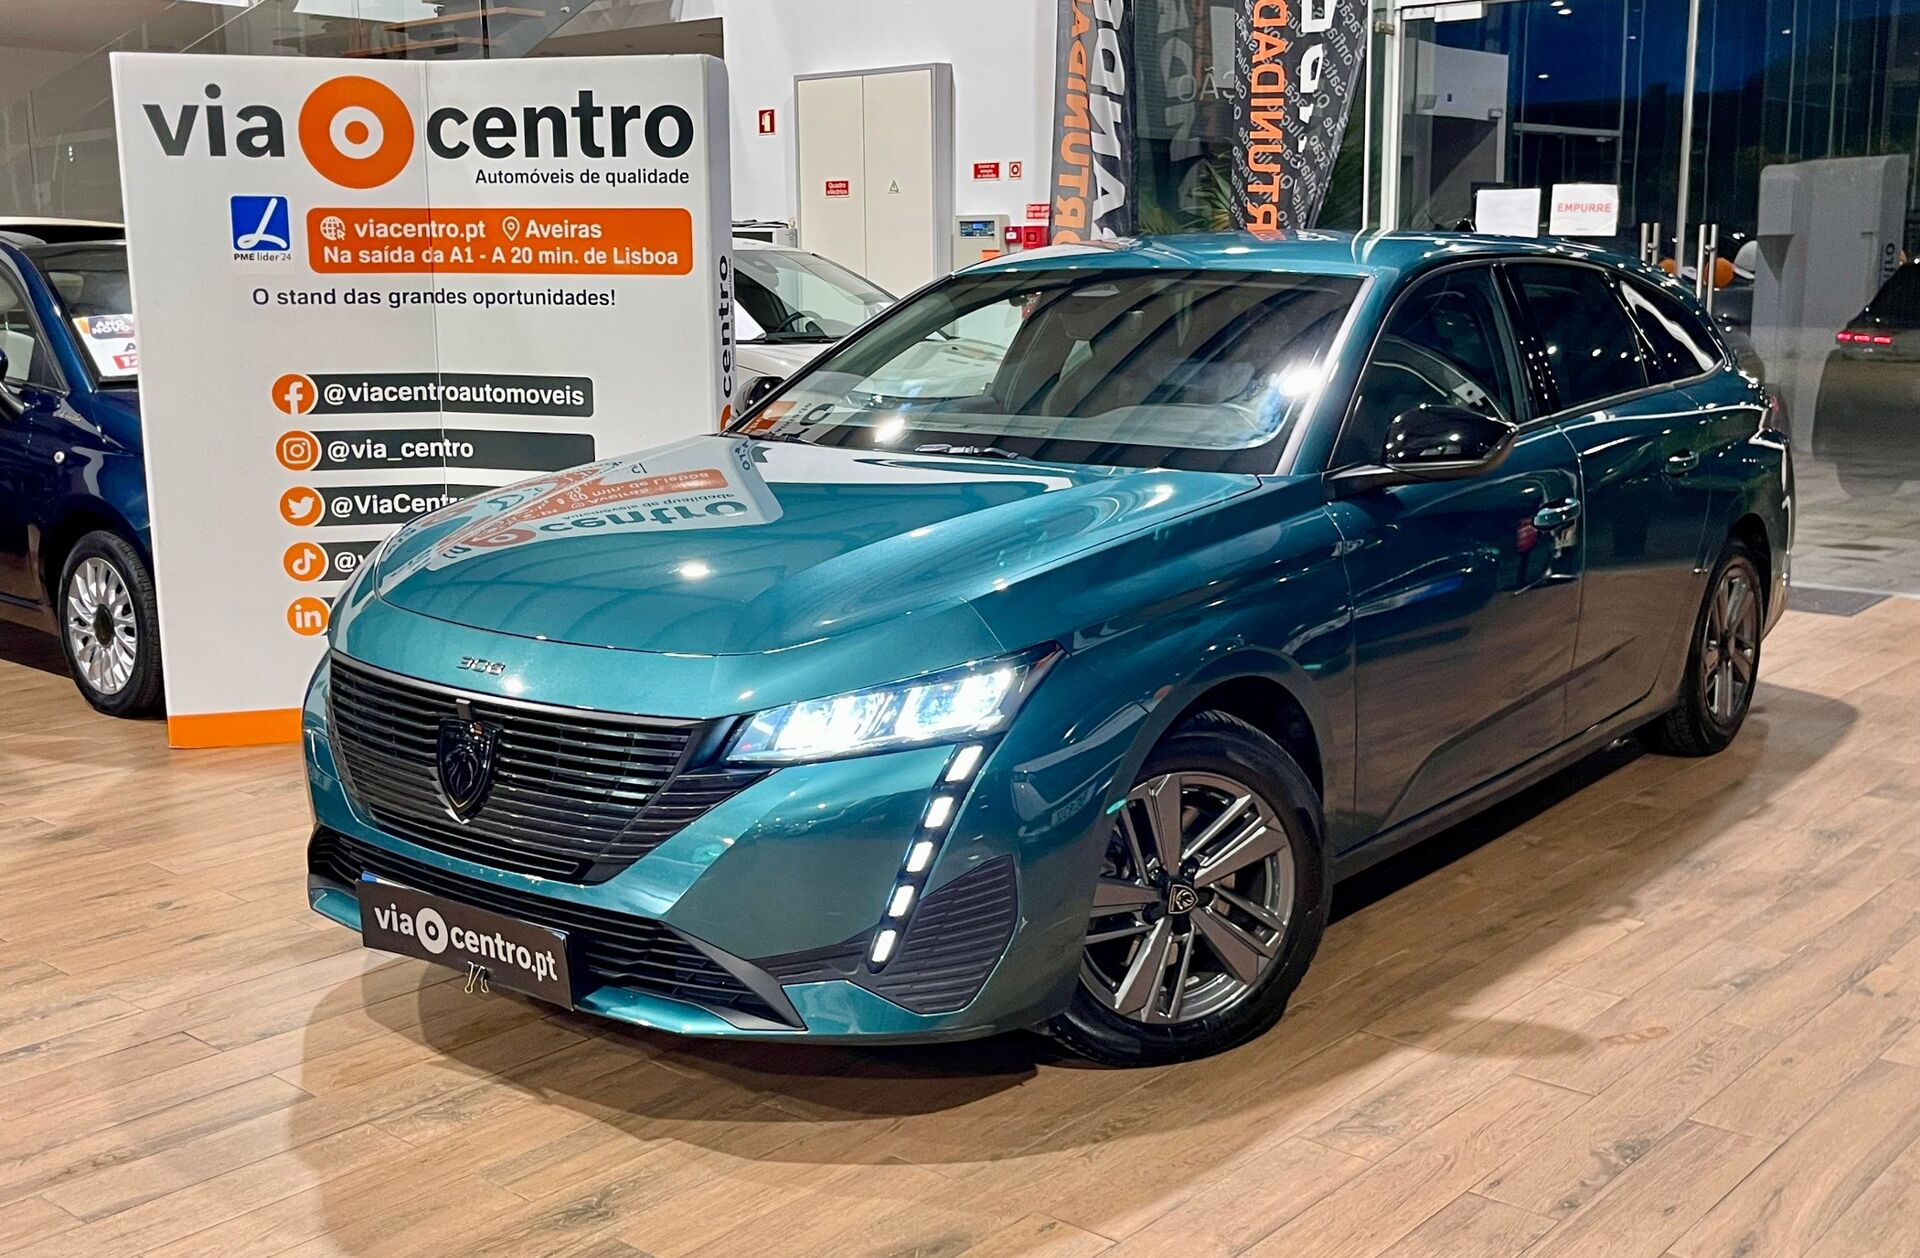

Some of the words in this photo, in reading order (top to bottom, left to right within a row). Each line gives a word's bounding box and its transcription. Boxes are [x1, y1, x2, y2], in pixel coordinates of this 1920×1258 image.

[141, 83, 286, 158] via
[426, 90, 694, 159] centro
[475, 168, 575, 184] Automóveis
[580, 169, 600, 184] de
[605, 169, 690, 187] qualidade
[1557, 202, 1612, 213] EMPURRE
[354, 219, 486, 243] viacentro.pt
[525, 219, 602, 239] Aveiras
[323, 246, 352, 264] Na
[358, 245, 416, 264] saída
[421, 246, 444, 264] da
[449, 246, 474, 264] A1
[491, 246, 506, 264] A
[510, 247, 533, 264] 20
[538, 247, 579, 264] min.
[583, 247, 607, 264] de
[613, 247, 678, 265] Lisboa
[252, 288, 270, 305] O
[276, 288, 336, 305] stand
[343, 288, 381, 305] das
[388, 288, 467, 308] grandes
[472, 288, 616, 309] oportunidades!
[718, 255, 733, 399] centro
[323, 382, 585, 406] @viacentroautomoveis
[327, 438, 474, 463] @via_centro
[331, 494, 465, 518] @ViaCent
[374, 903, 415, 937] via
[450, 925, 558, 982] centro.pt
